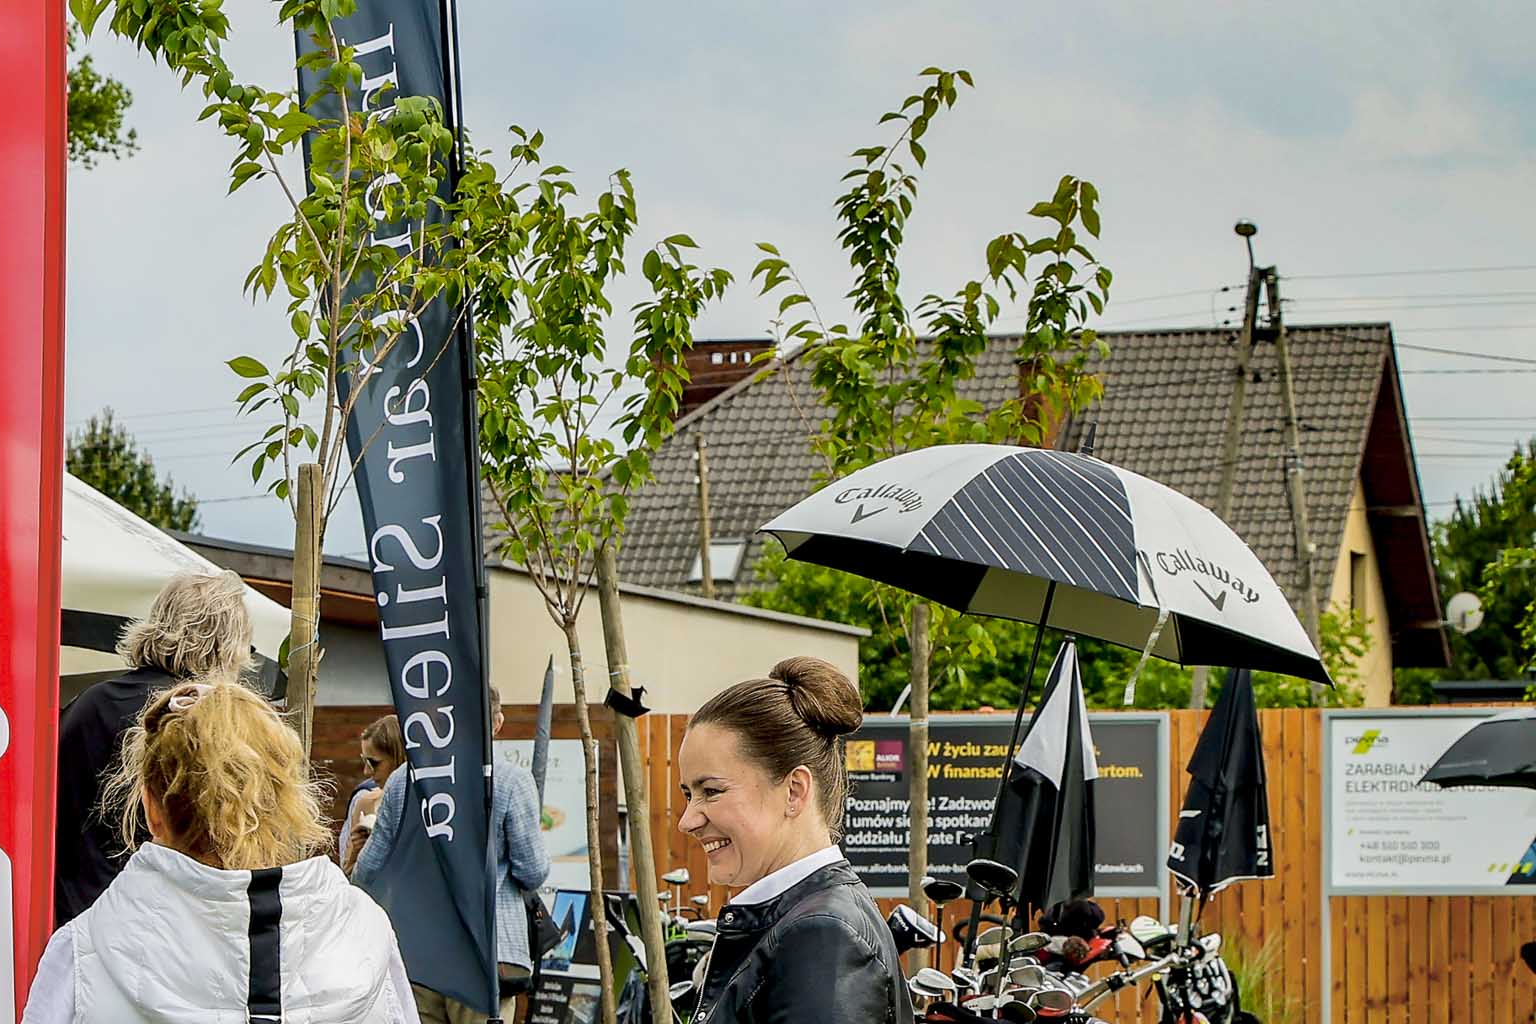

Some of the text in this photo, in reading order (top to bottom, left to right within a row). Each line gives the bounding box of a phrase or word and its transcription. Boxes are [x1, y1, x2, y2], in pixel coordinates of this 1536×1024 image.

[835, 483, 923, 514] Callaway
[1156, 547, 1260, 604] Callaway
[943, 741, 981, 760] życiu
[1098, 763, 1144, 779] ertom.
[1345, 763, 1416, 777] ZARABIAJ
[846, 796, 912, 814] Poznajmy
[852, 813, 895, 828] umów
[845, 830, 903, 845] oddziału
